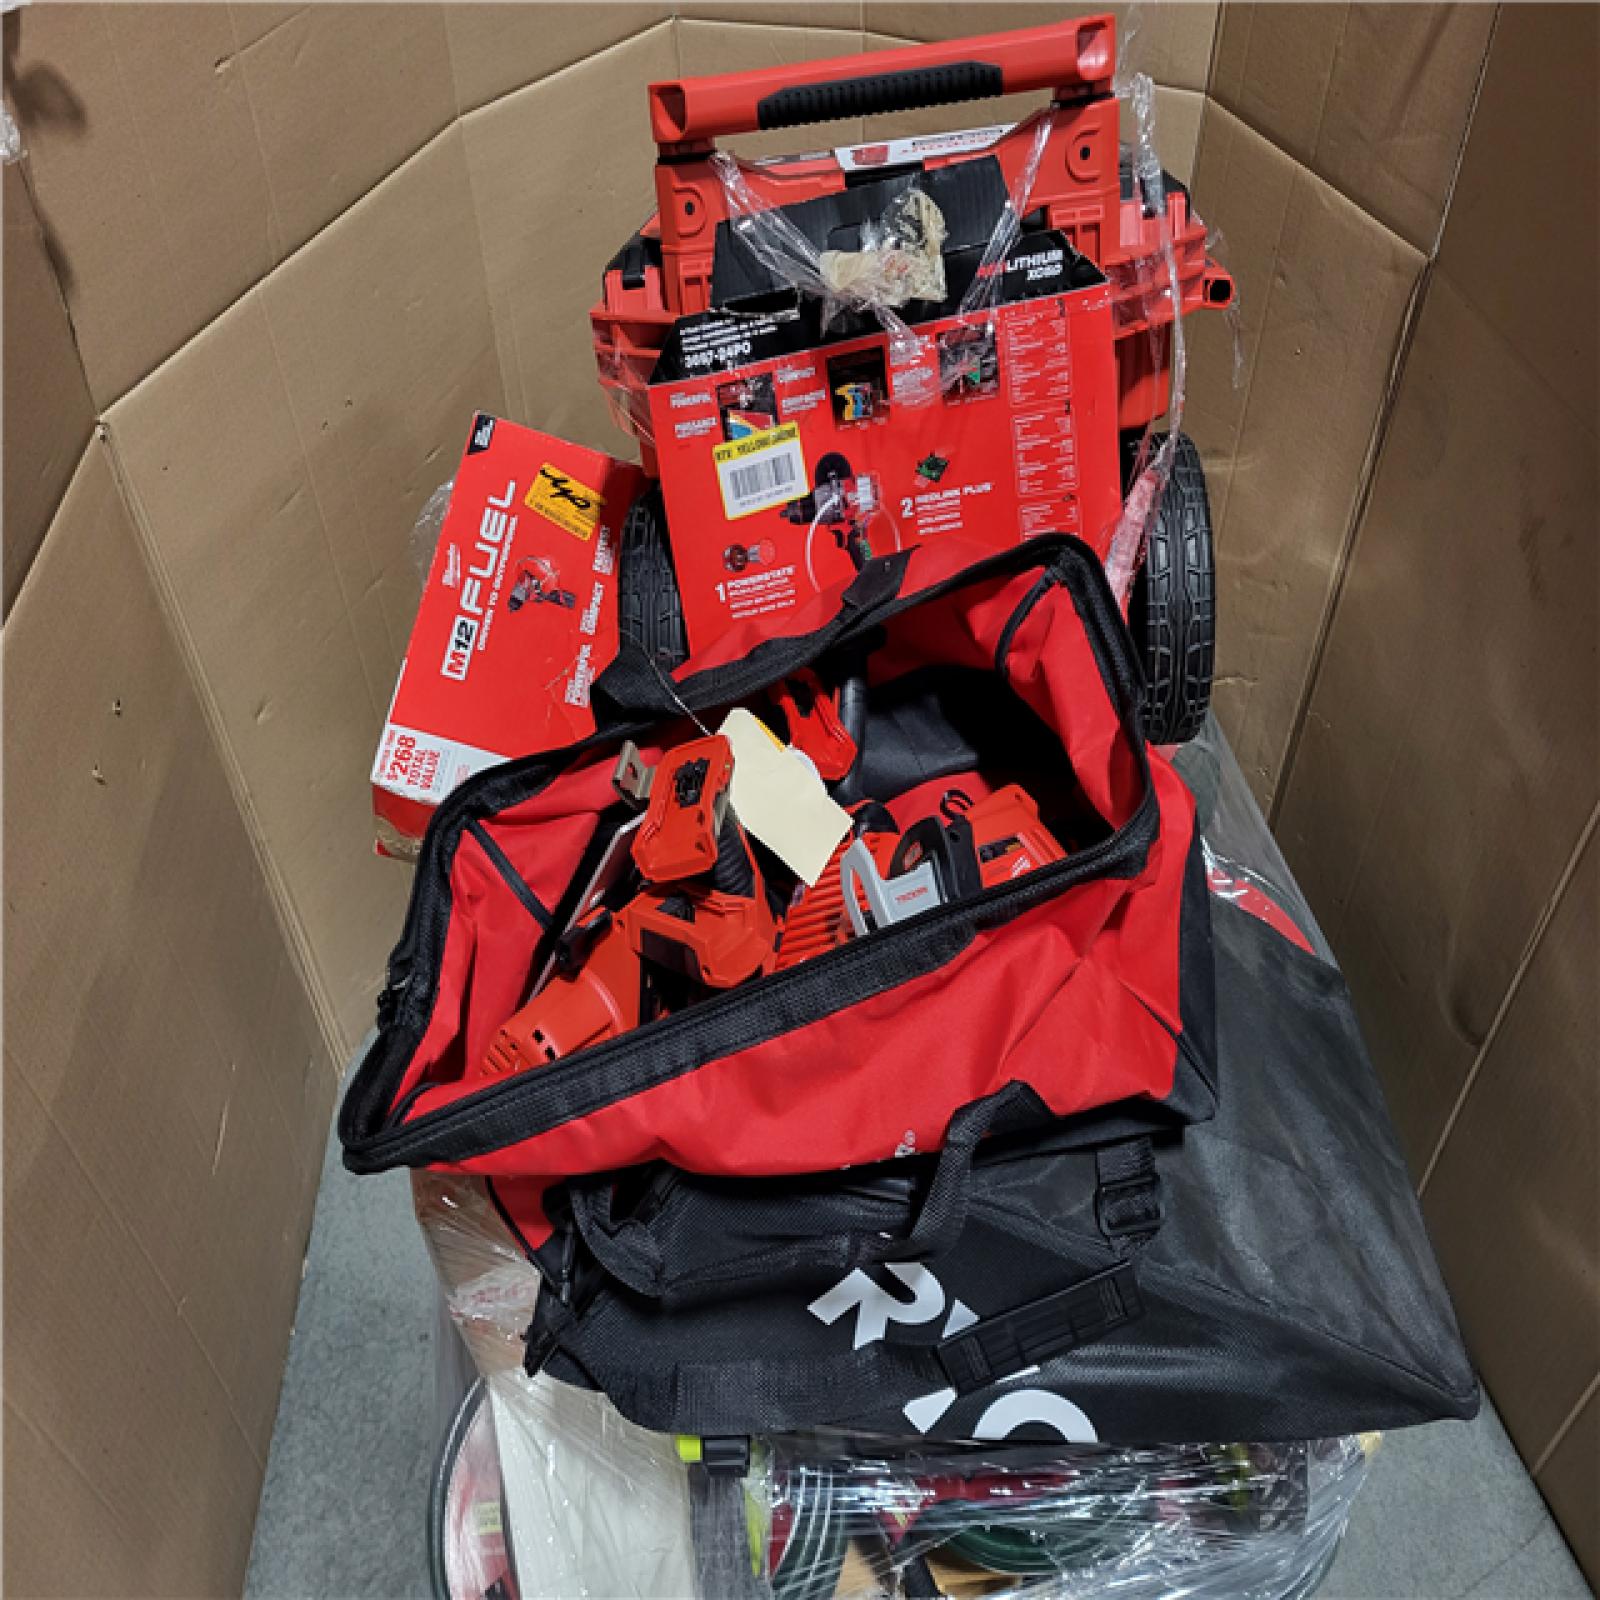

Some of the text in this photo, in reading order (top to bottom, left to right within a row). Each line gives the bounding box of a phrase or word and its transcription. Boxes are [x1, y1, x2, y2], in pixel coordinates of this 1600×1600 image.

[901, 497, 913, 518] 2
[443, 480, 515, 679] M12 FUEL
[715, 582, 726, 603] 1
[385, 734, 416, 781] $268
[419, 749, 440, 790] VALUE
